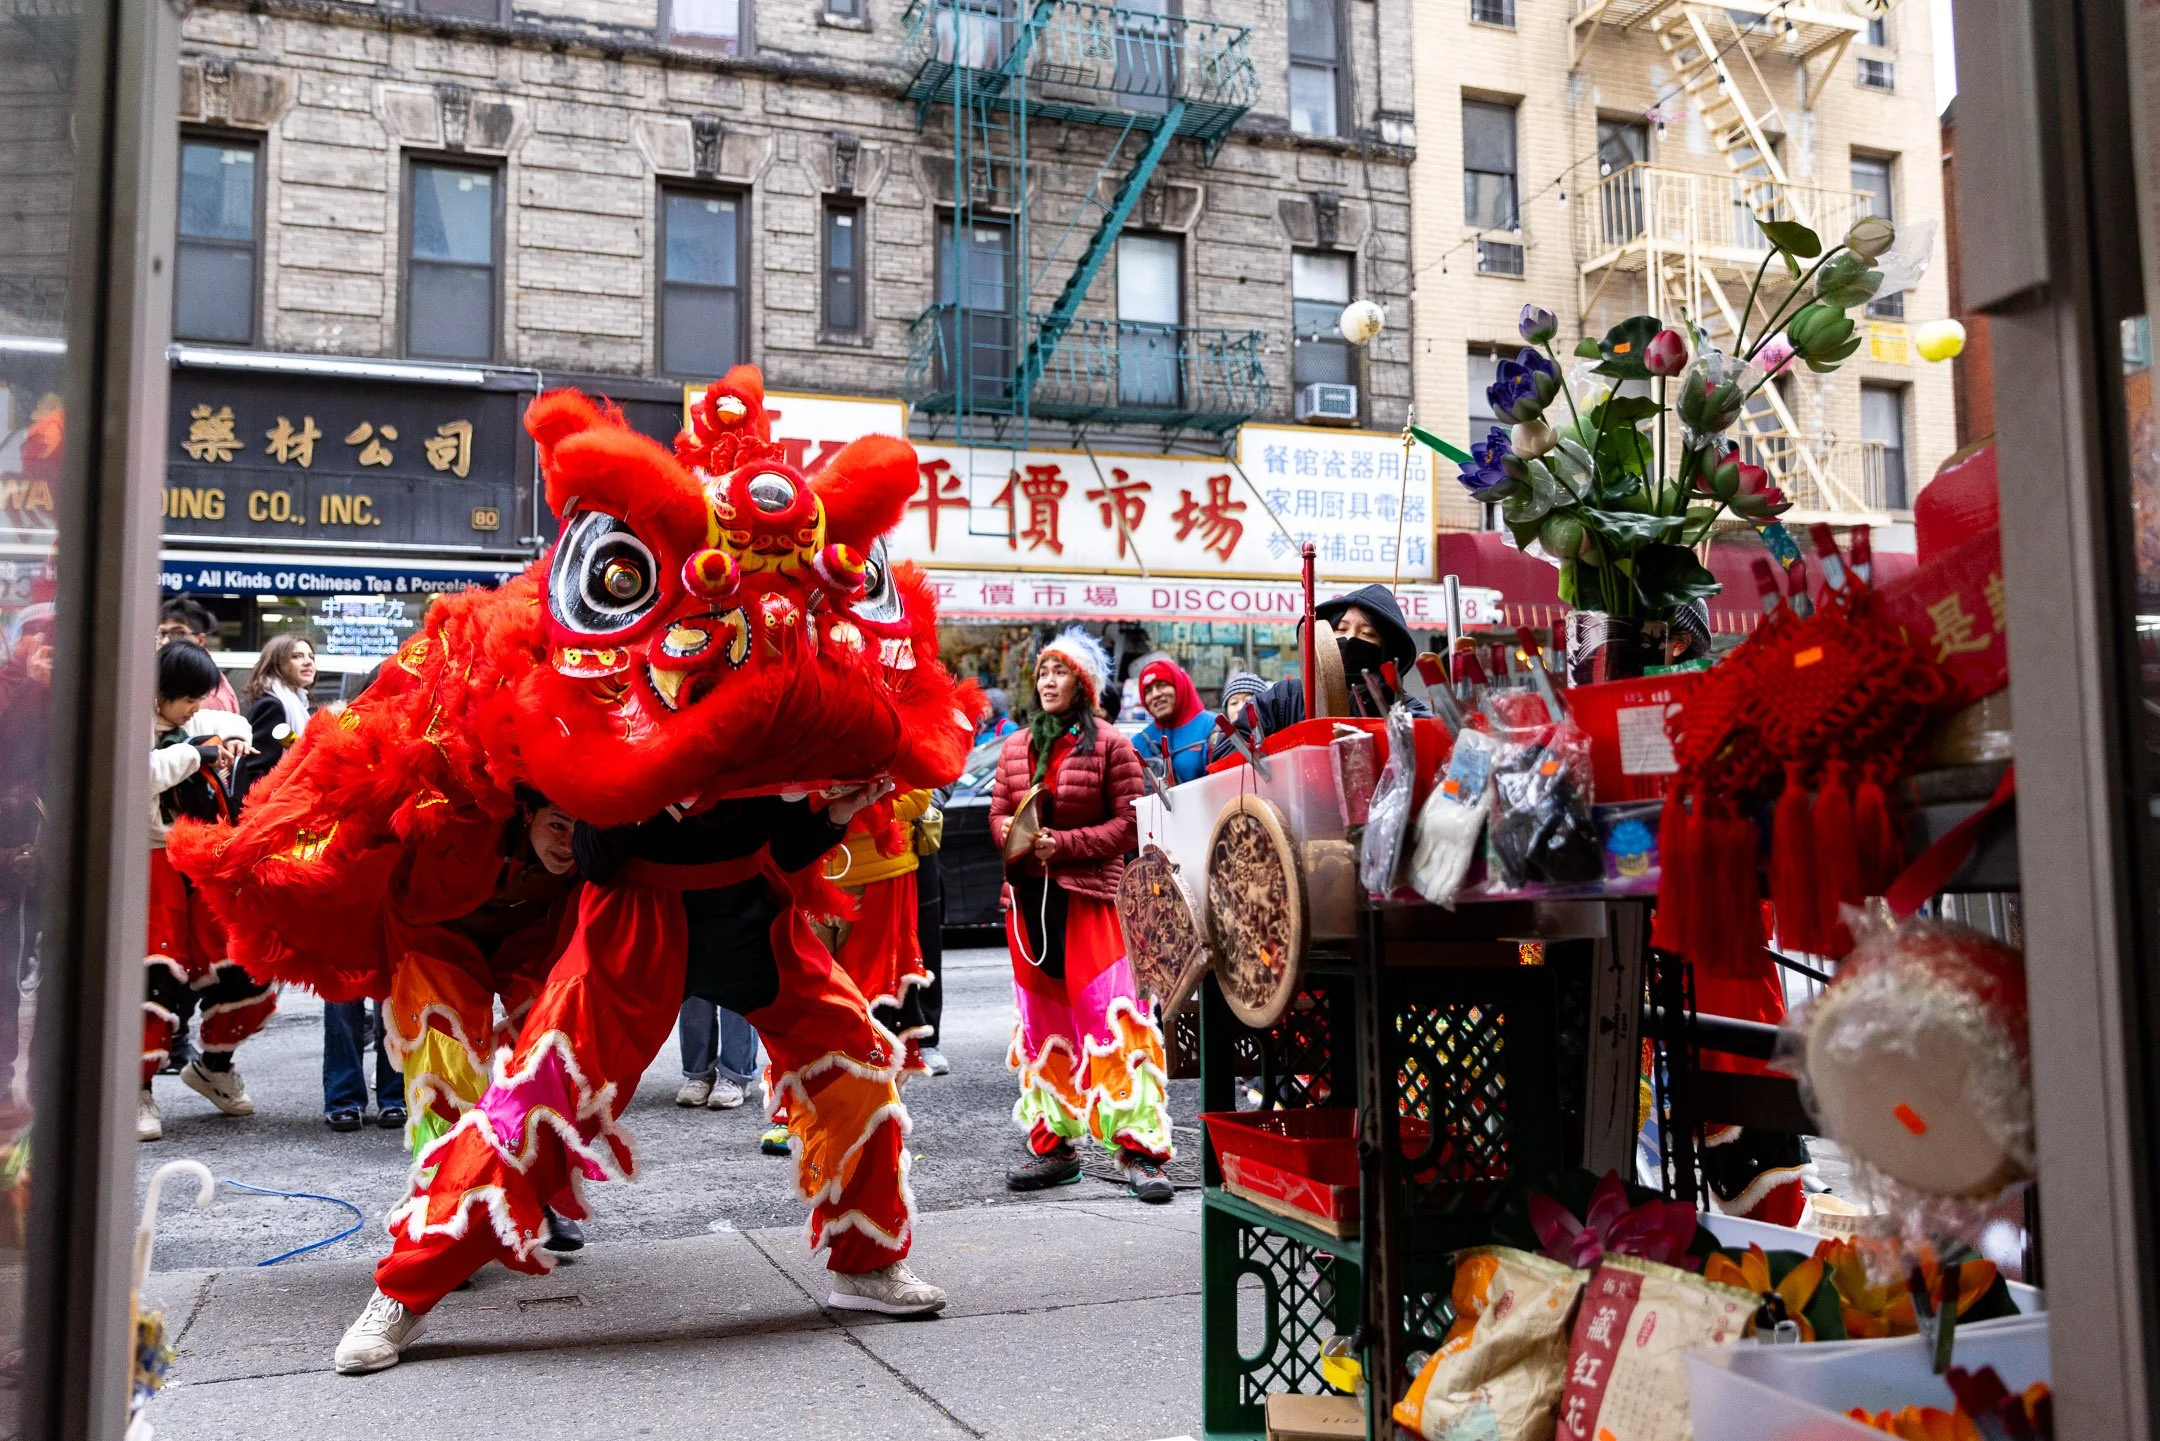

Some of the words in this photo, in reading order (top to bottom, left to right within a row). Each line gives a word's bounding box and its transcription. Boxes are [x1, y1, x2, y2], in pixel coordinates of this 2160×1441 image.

[181, 403, 473, 478] 藥材公司
[319, 494, 381, 526] INC.
[475, 511, 497, 526] 80
[909, 457, 1248, 563] 平價市場
[197, 570, 221, 588] All
[224, 570, 272, 589] Kinds
[275, 572, 297, 590] Of
[297, 573, 362, 592] Chinese
[365, 575, 392, 592] Tea
[395, 576, 408, 592] &
[1152, 588, 1305, 614] DISCOUN
[1565, 1306, 1617, 1438] 藏红花
